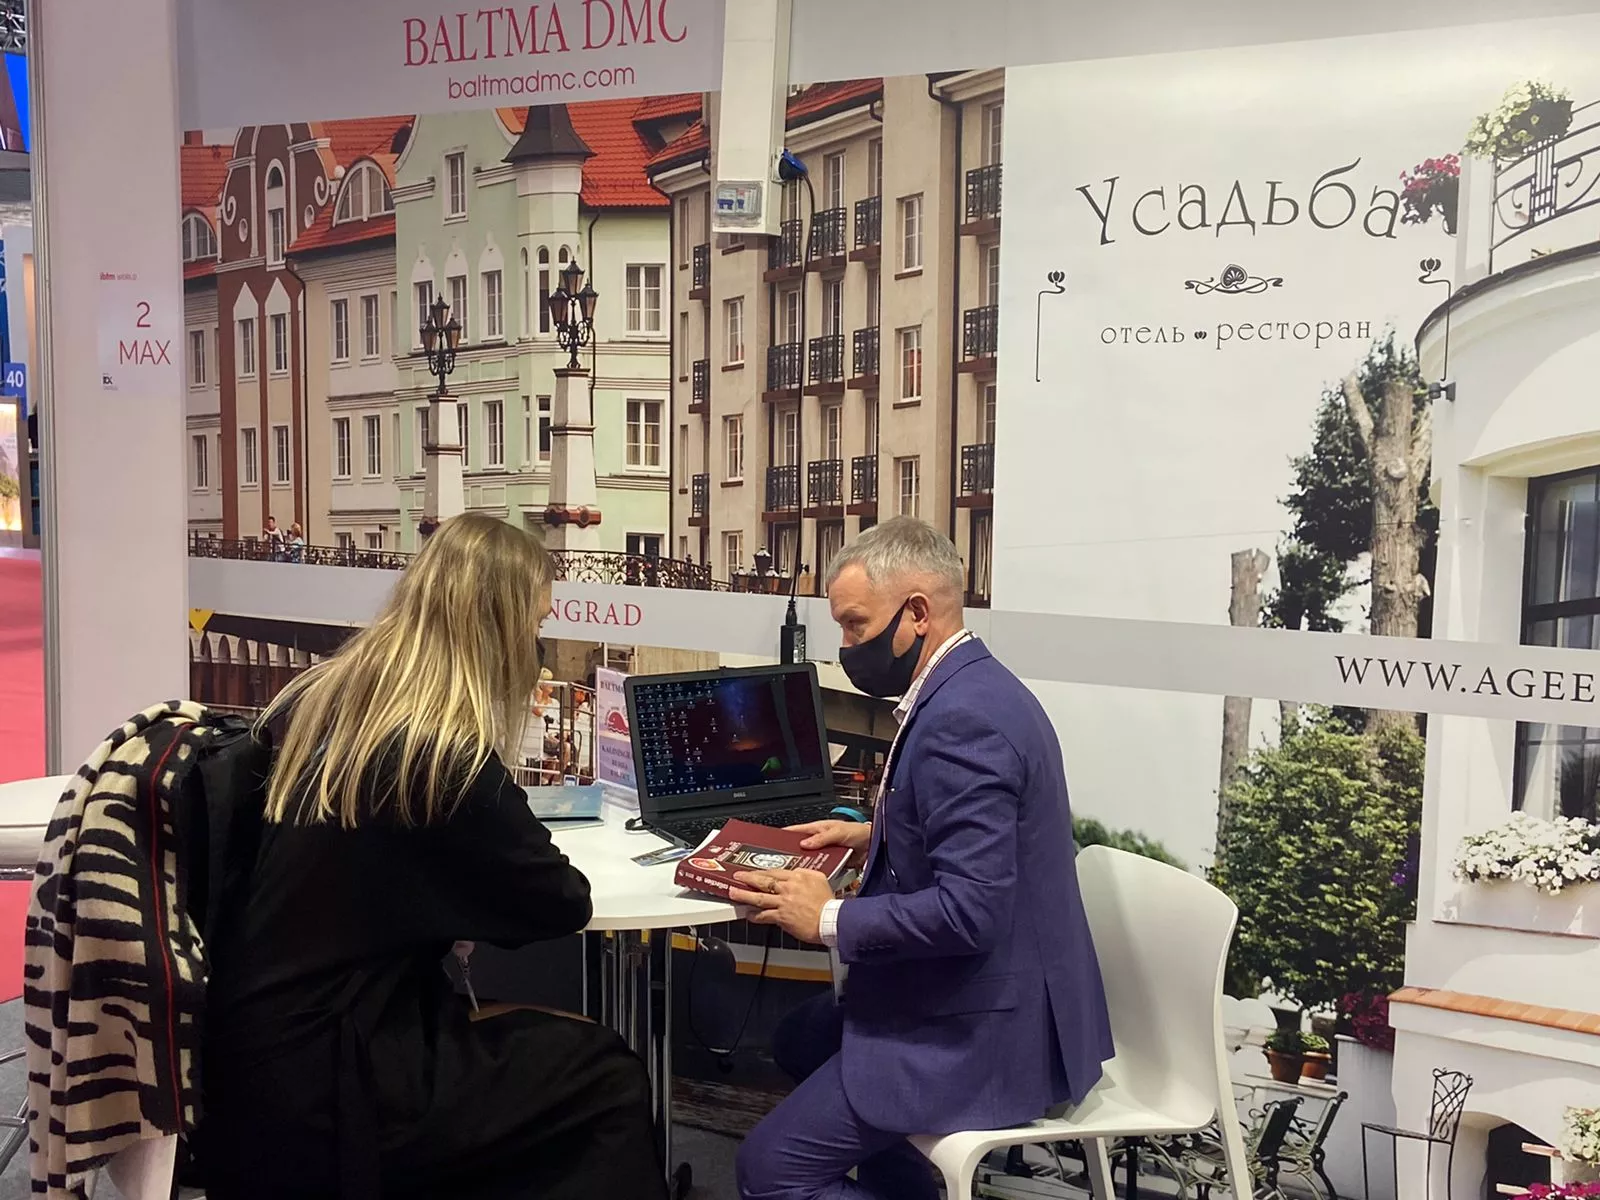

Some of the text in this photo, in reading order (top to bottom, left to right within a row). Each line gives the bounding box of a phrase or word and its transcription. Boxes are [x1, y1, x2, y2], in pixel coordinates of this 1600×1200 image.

[403, 0, 688, 67] BALTMA DMC
[448, 66, 635, 99] baltmadmc.com
[1075, 157, 1401, 246] Усадьба
[136, 301, 151, 328] 2
[1100, 320, 1372, 350] отель ресторан
[119, 339, 171, 365] MAX
[6, 370, 24, 388] 40
[1334, 655, 1596, 703] WWW.AGEE
